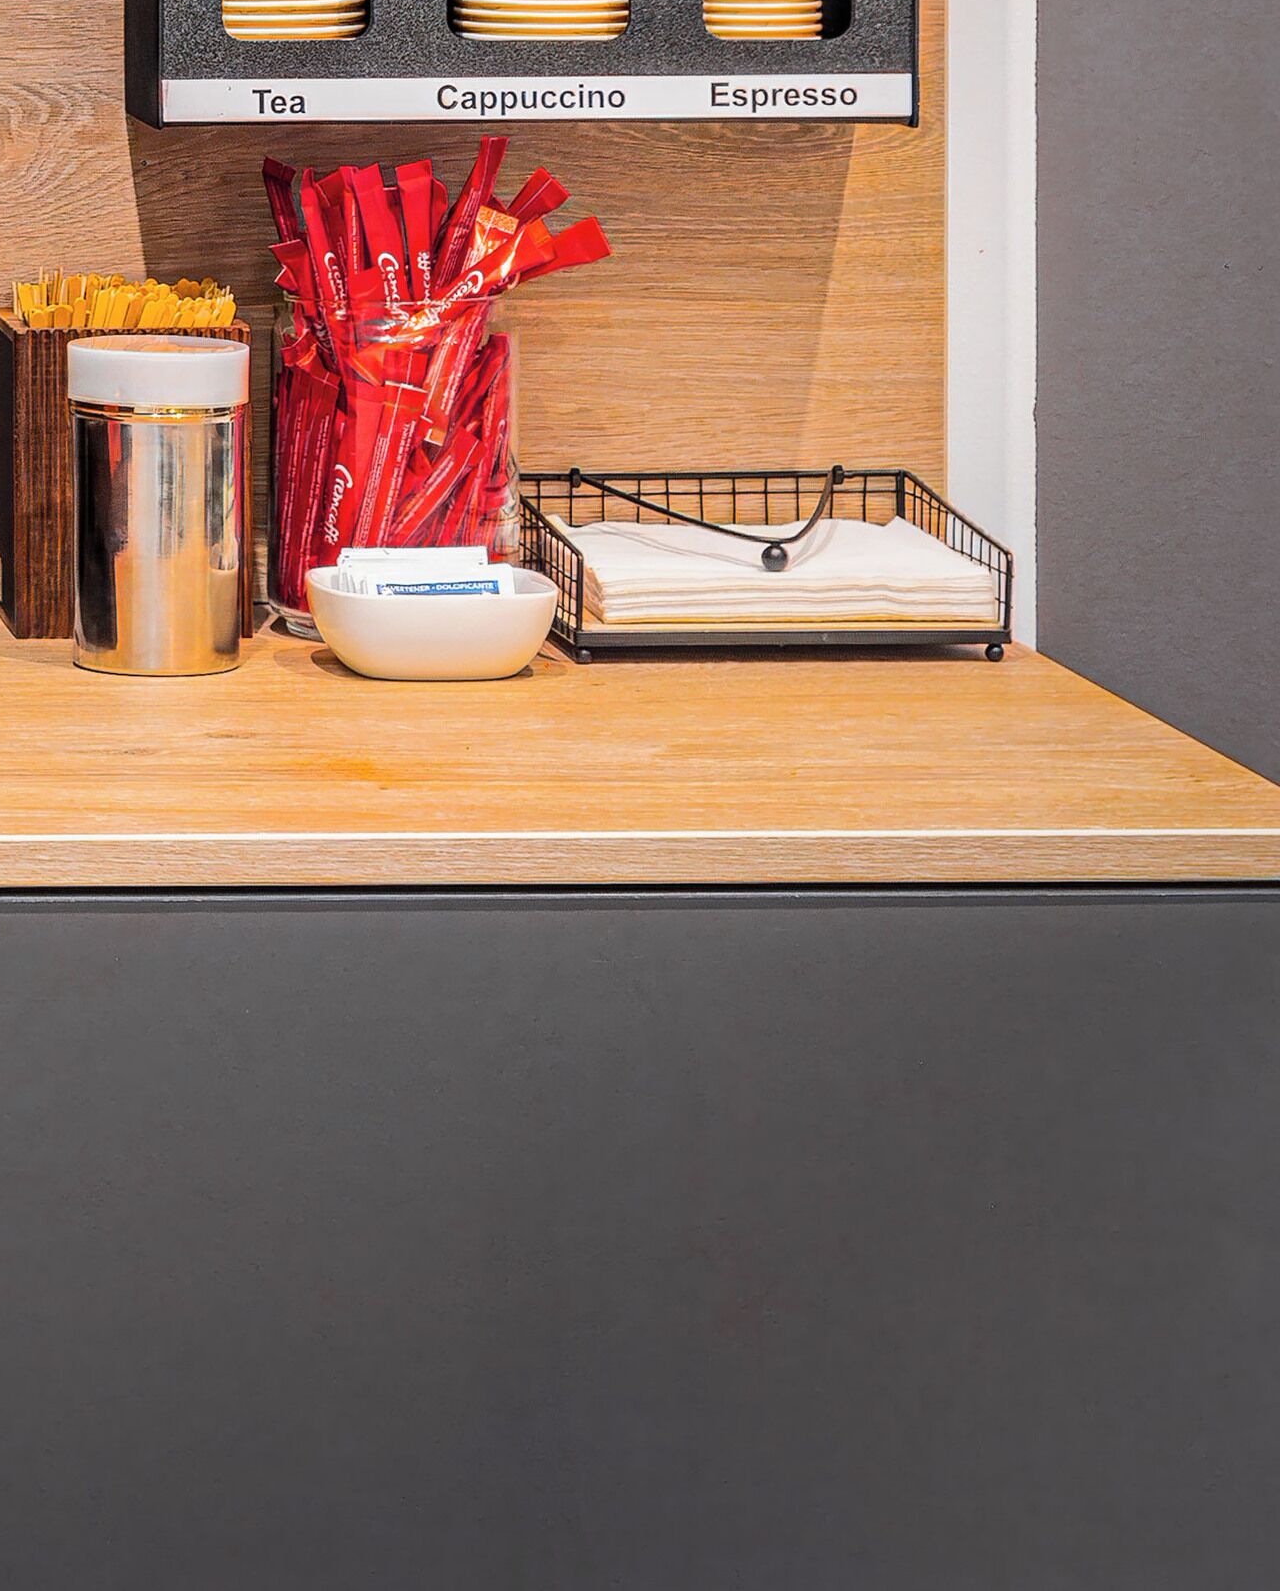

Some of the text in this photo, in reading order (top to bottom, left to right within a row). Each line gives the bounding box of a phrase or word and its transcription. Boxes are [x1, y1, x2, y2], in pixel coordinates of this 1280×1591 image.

[251, 88, 307, 115] Tea
[436, 84, 626, 115] Cappuccino
[709, 81, 859, 111] Espresso
